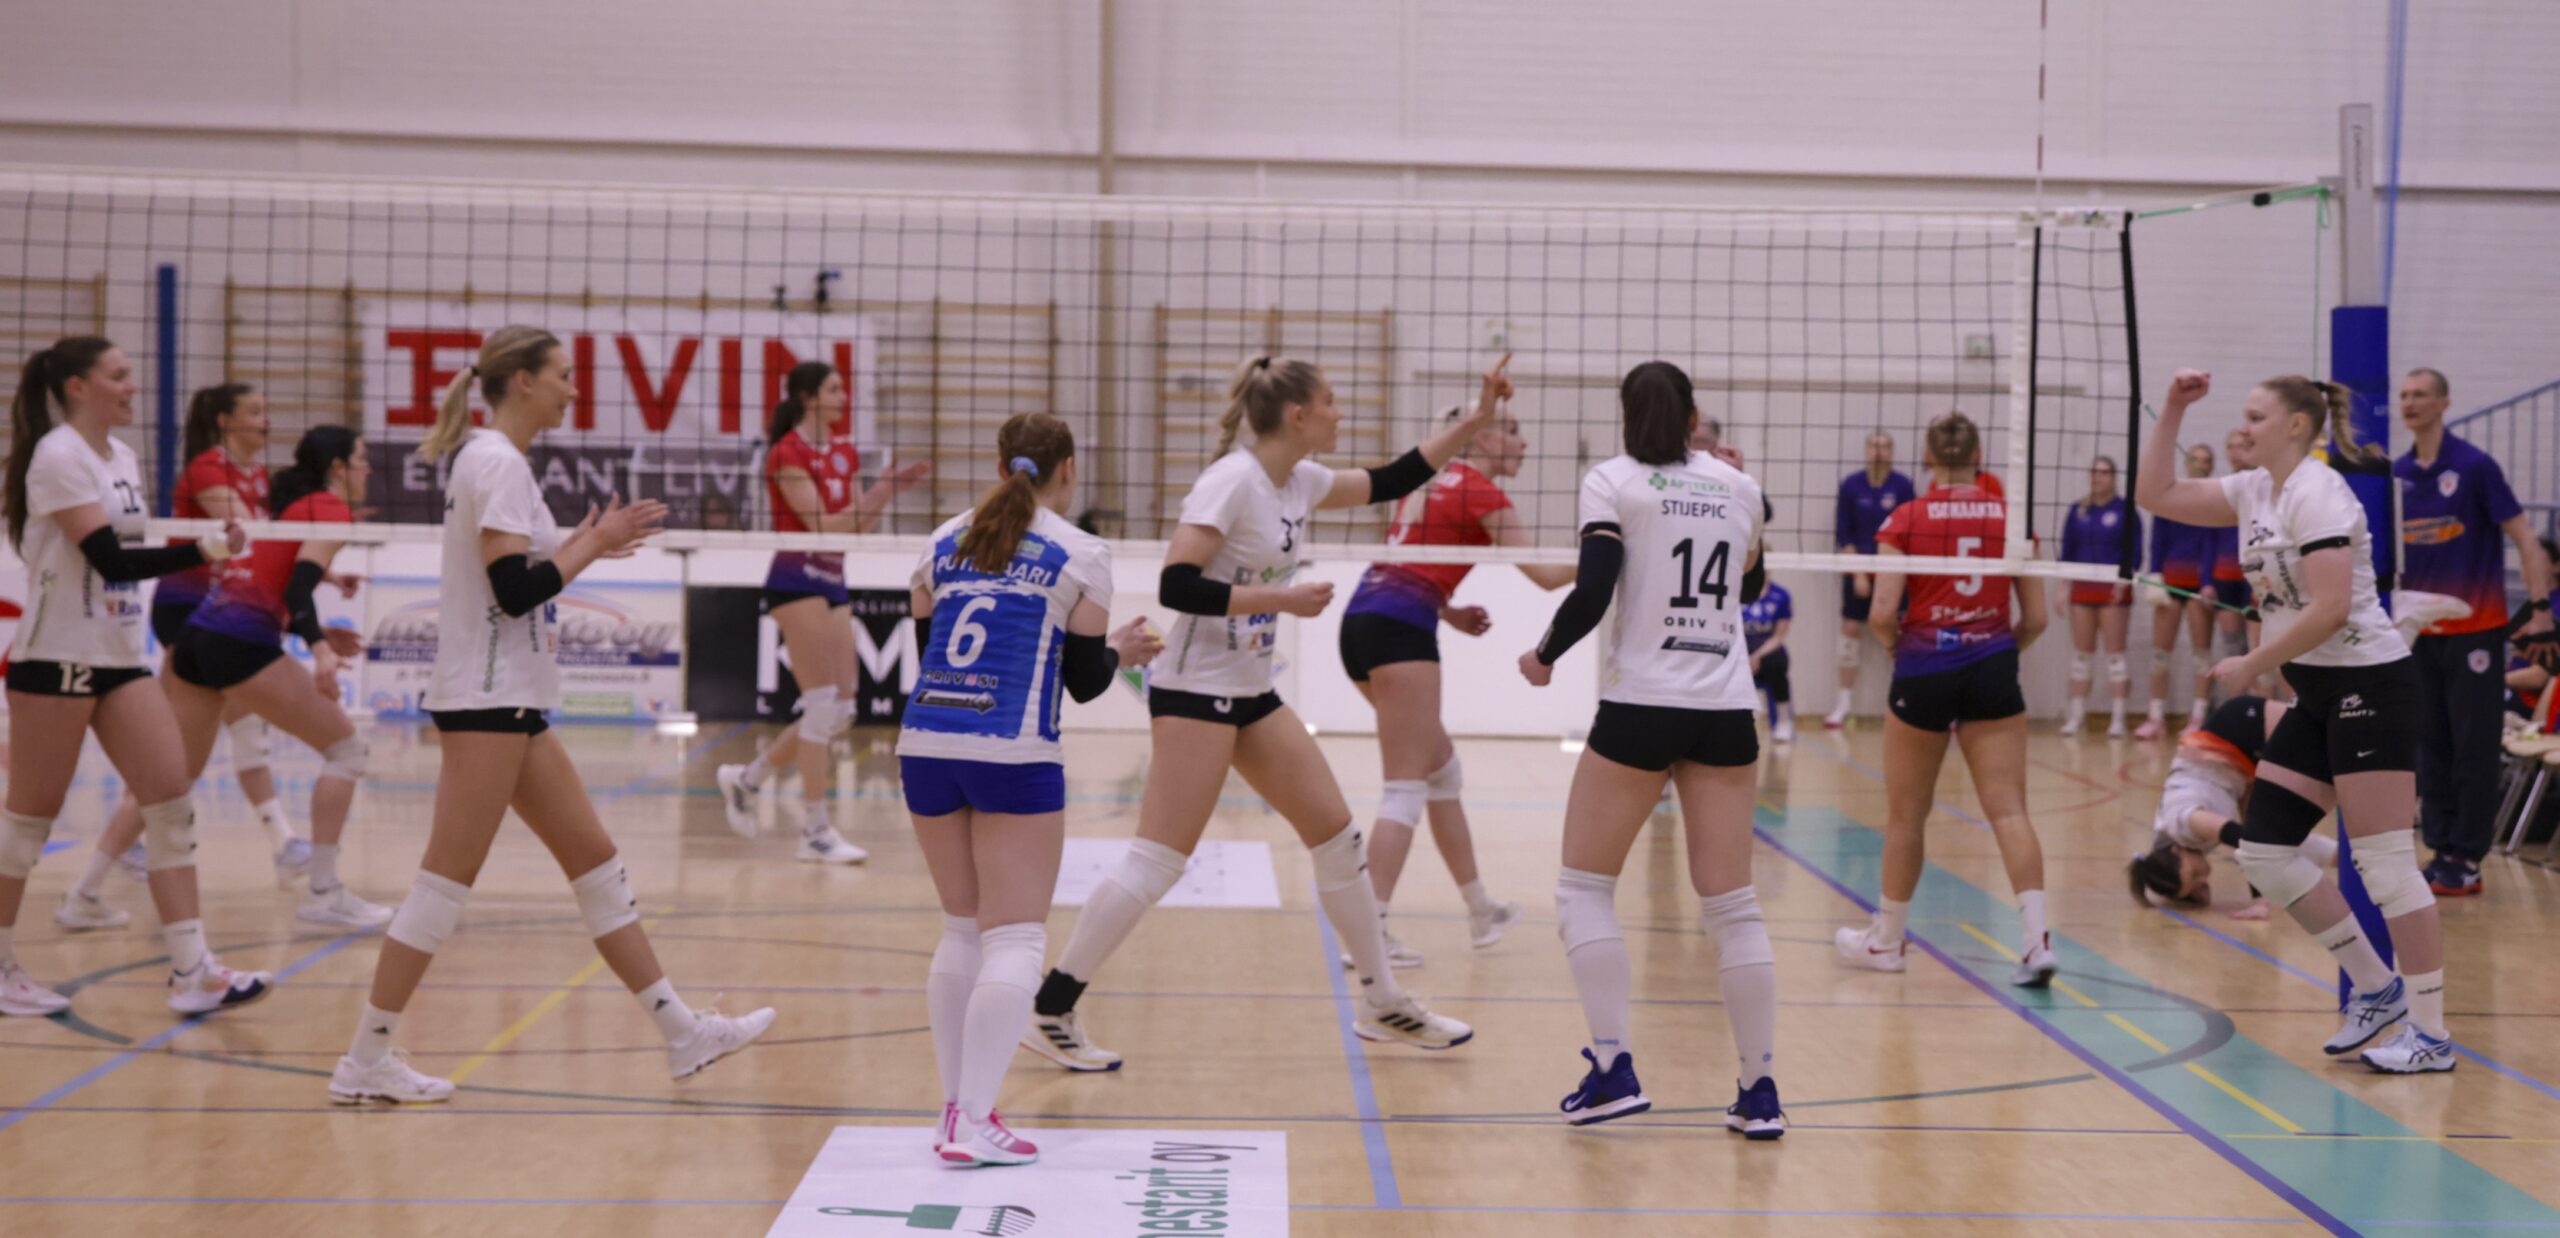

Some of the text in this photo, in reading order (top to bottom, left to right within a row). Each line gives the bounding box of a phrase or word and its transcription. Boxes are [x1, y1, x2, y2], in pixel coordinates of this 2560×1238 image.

[1661, 499, 1728, 519] STIJEPIC
[1669, 537, 1730, 610] 14
[1954, 535, 1984, 597] 5
[945, 595, 998, 669] 6
[58, 662, 94, 694] 12
[1150, 1141, 1259, 1163] oy
